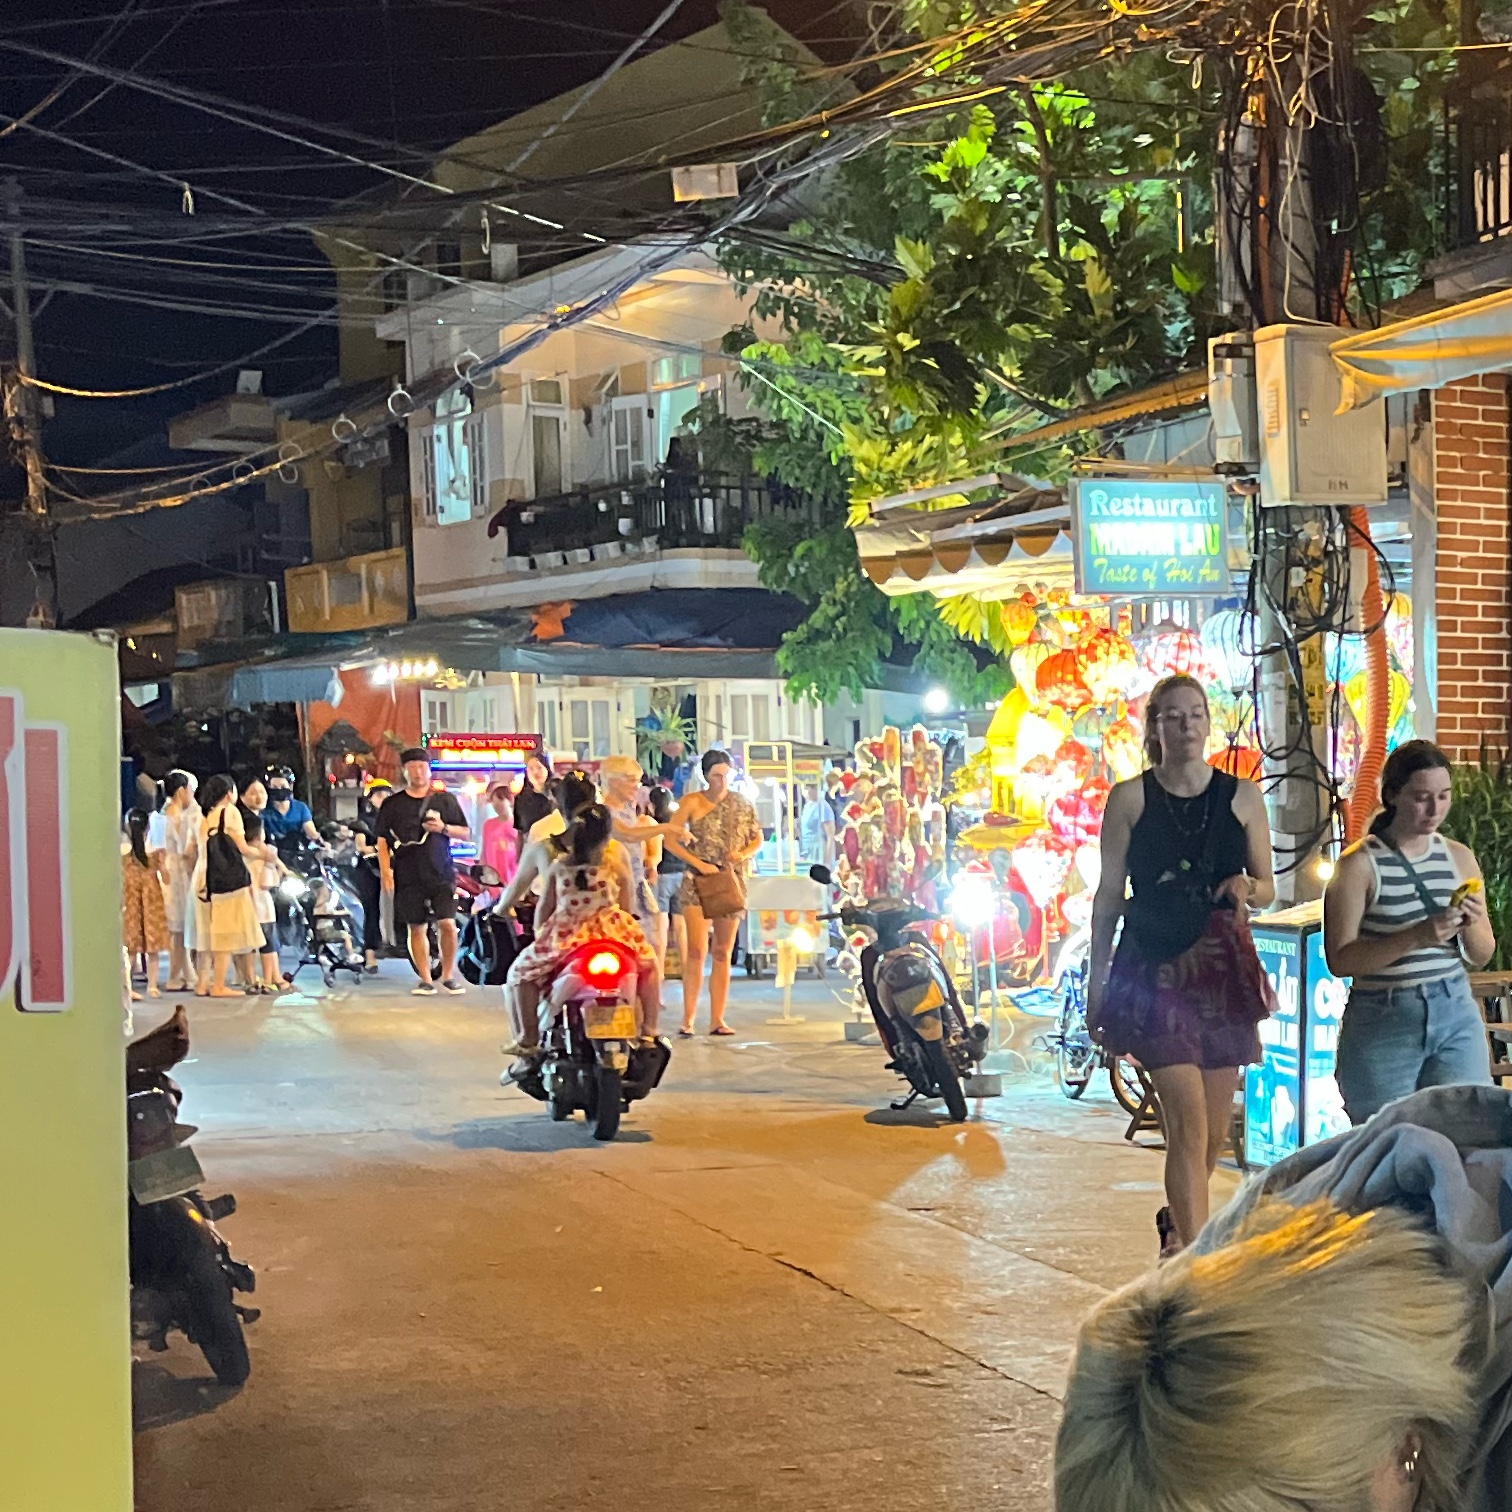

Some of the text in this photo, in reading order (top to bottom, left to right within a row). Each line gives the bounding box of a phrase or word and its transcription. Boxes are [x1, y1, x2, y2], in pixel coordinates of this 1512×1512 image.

[1089, 489, 1217, 517] Restaurant
[1179, 523, 1221, 556] LAU
[1093, 557, 1138, 584] Taste
[1142, 560, 1158, 590] of
